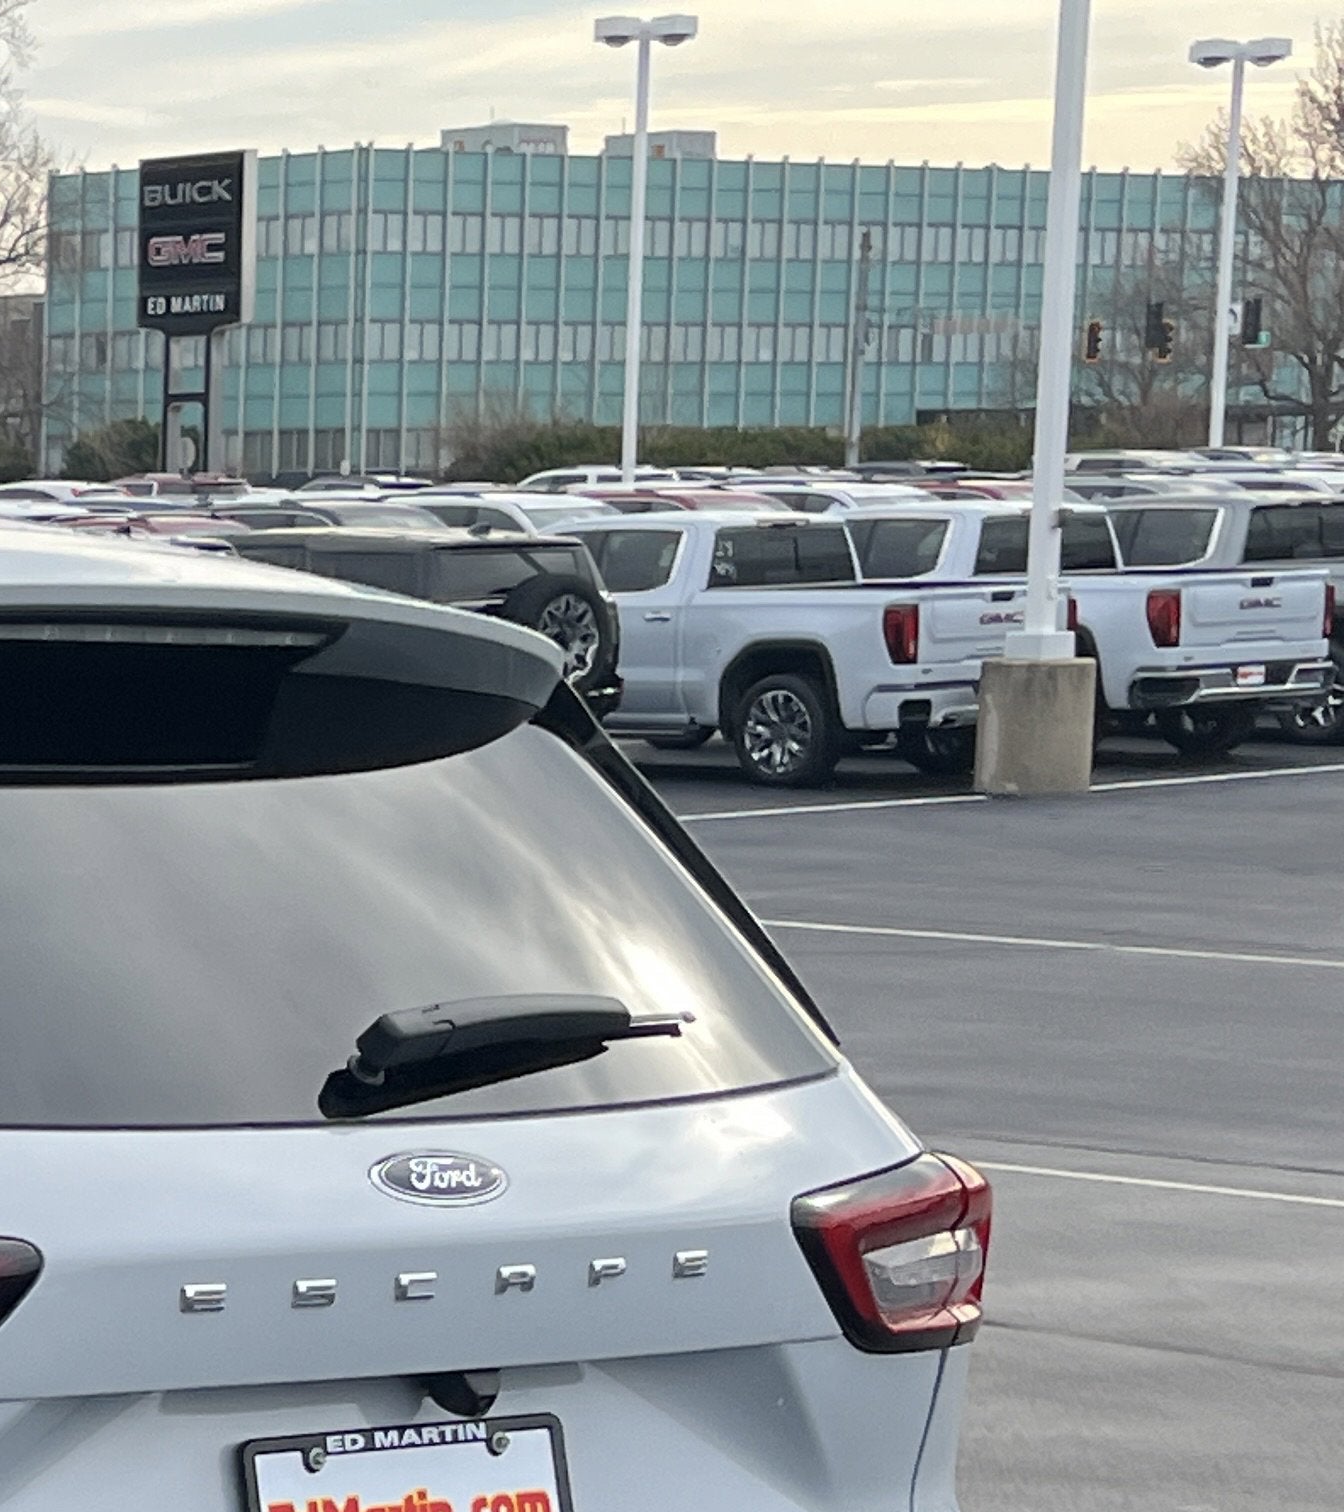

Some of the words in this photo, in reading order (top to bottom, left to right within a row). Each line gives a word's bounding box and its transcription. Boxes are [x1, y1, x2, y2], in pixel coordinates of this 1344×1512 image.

[143, 179, 232, 206] BUICK
[149, 233, 225, 266] GMC
[147, 297, 166, 314] ED
[171, 294, 225, 313] MARTIN
[409, 1157, 481, 1189] Ford
[180, 1249, 708, 1312] ESCAPE
[326, 1434, 365, 1453] ED
[374, 1422, 487, 1449] MARTIN
